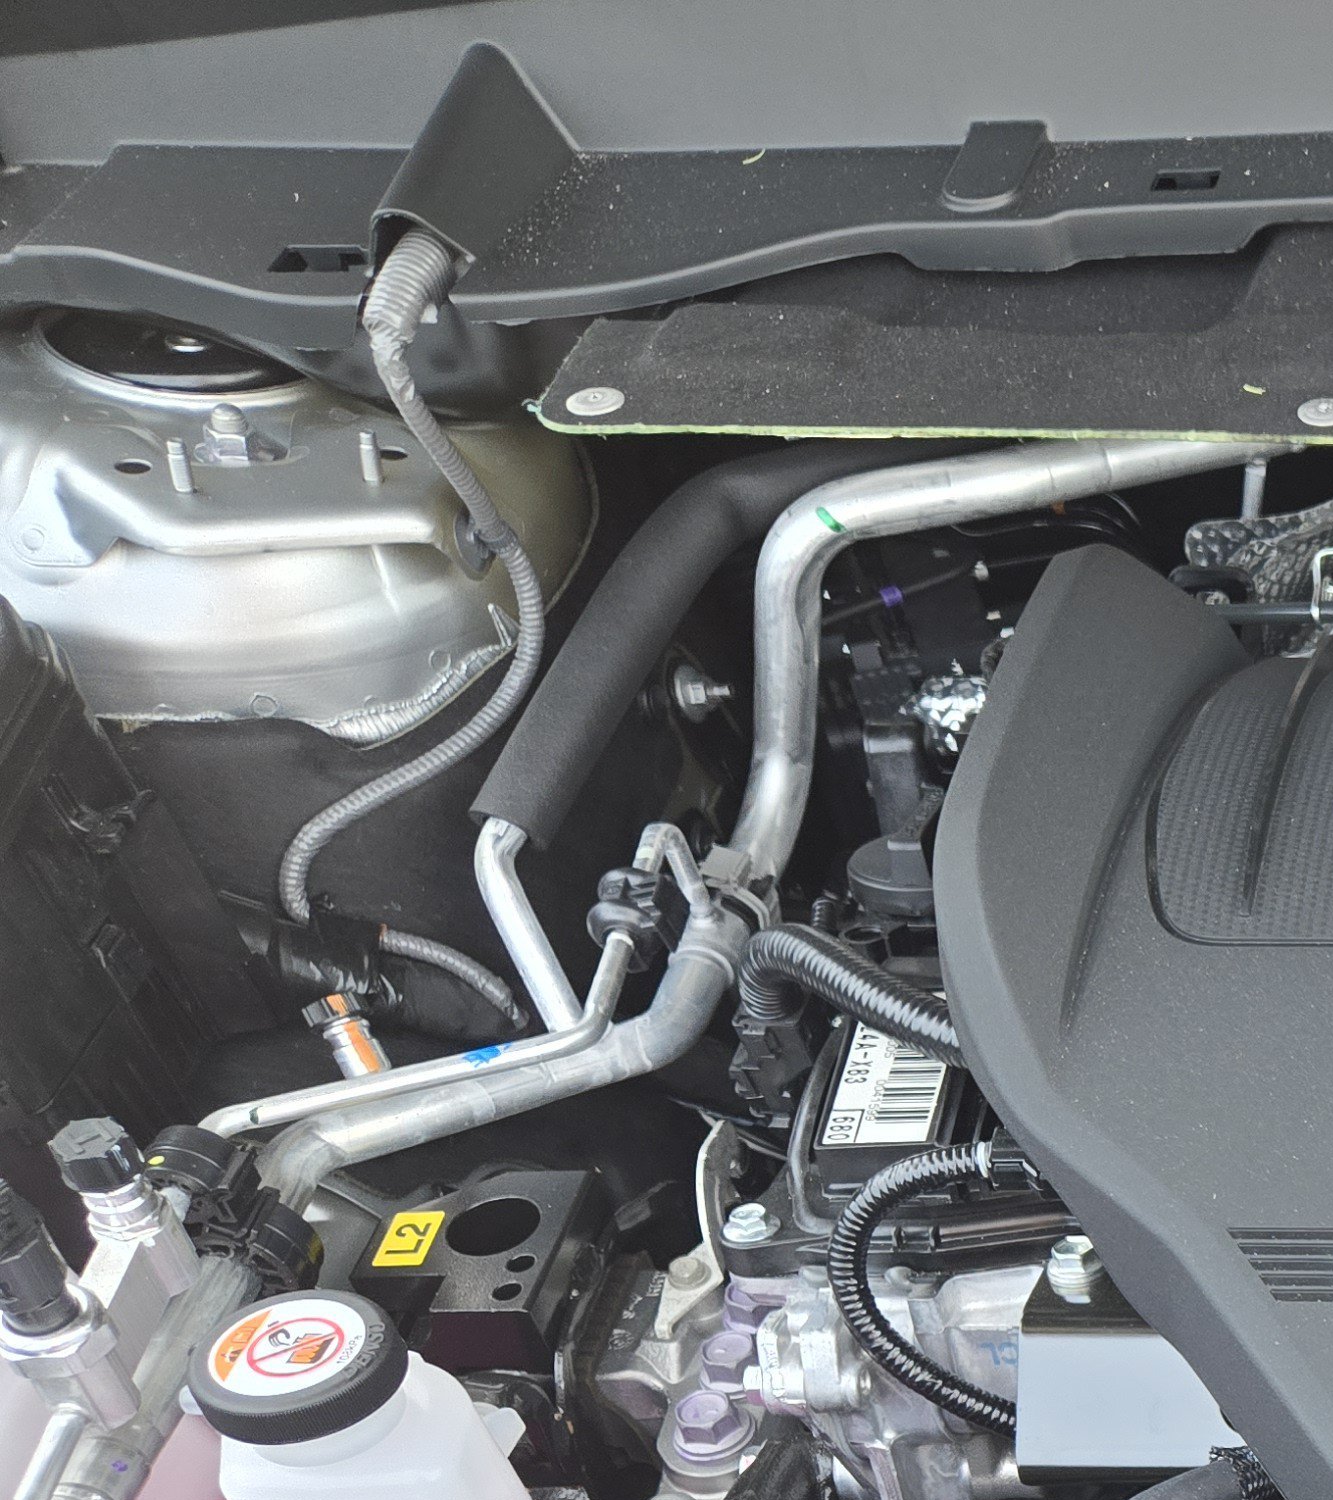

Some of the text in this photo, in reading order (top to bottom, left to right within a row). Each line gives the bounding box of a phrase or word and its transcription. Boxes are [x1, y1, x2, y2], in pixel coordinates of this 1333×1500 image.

[844, 1026, 880, 1084] 4A-X83
[827, 1116, 855, 1140] 680
[384, 1222, 433, 1255] L2
